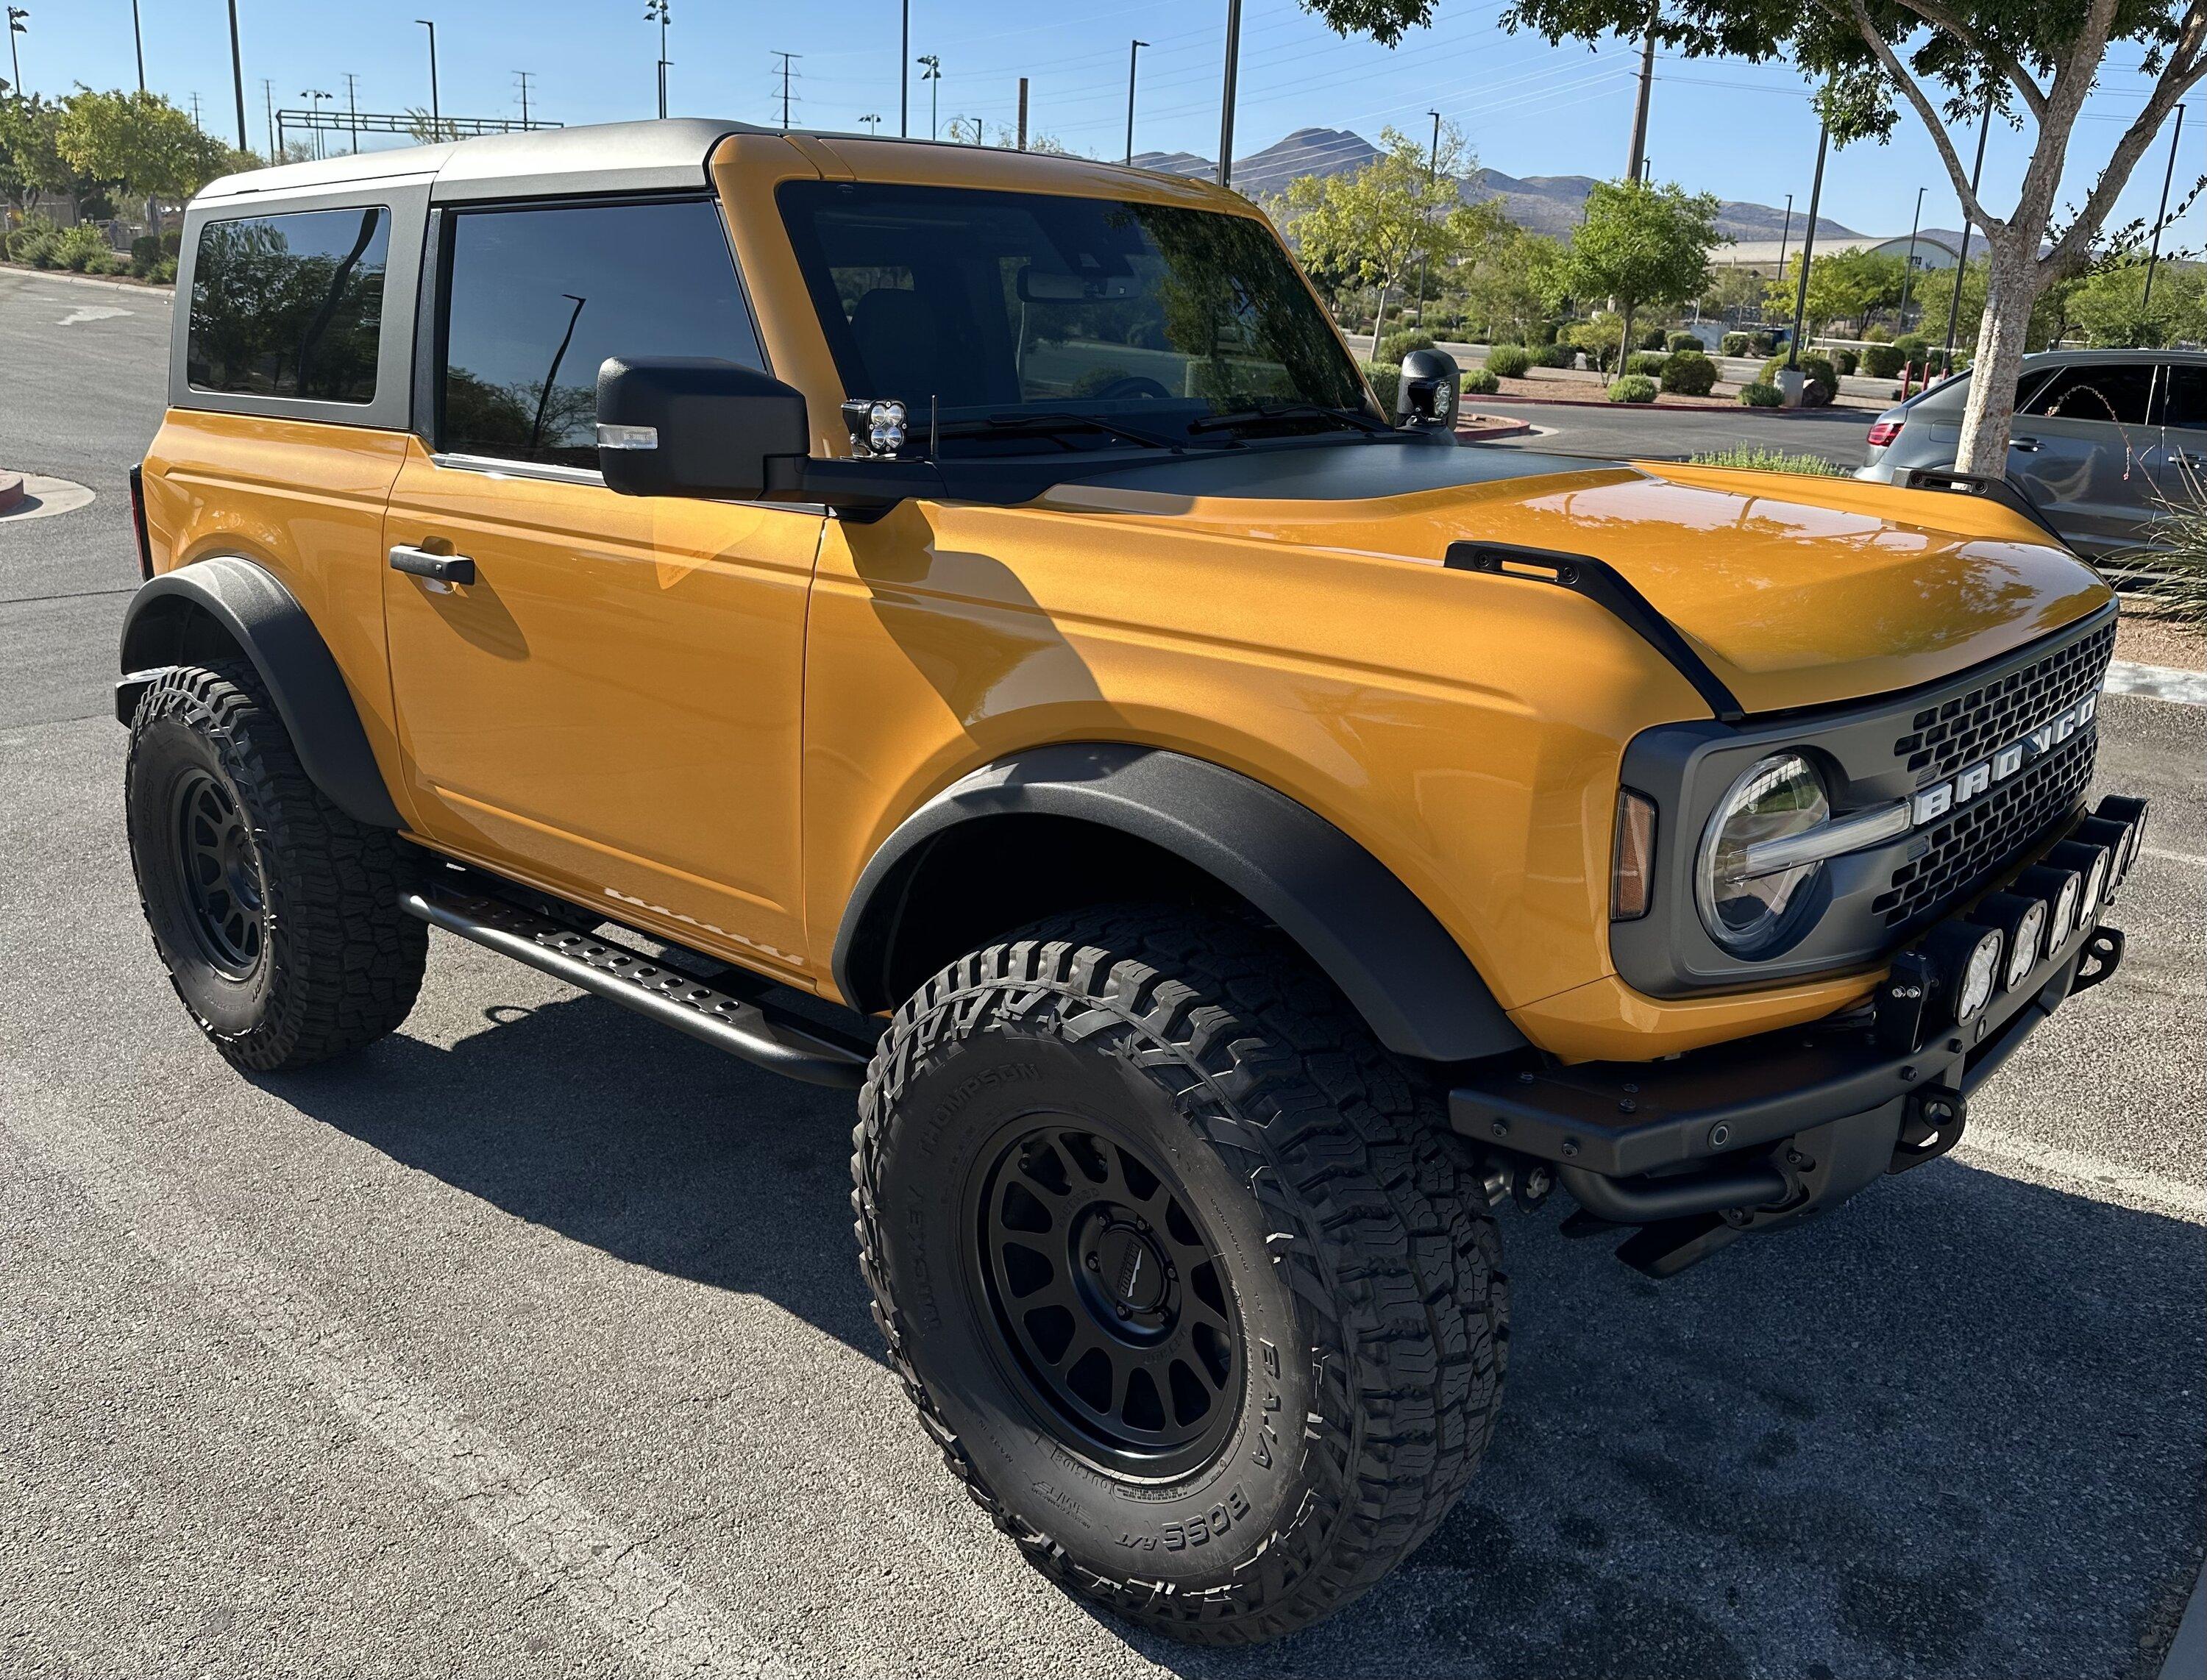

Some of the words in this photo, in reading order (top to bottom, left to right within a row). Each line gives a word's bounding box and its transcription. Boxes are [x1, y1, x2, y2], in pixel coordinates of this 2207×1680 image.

[1913, 691, 2097, 825] BRONCO
[917, 1061, 1044, 1156] THOMPSON
[1251, 1336, 1282, 1470] BAJA
[1055, 1453, 1109, 1490] OUTSIDE
[1115, 1532, 1159, 1551] A/T
[1162, 1482, 1252, 1552] BOSS
